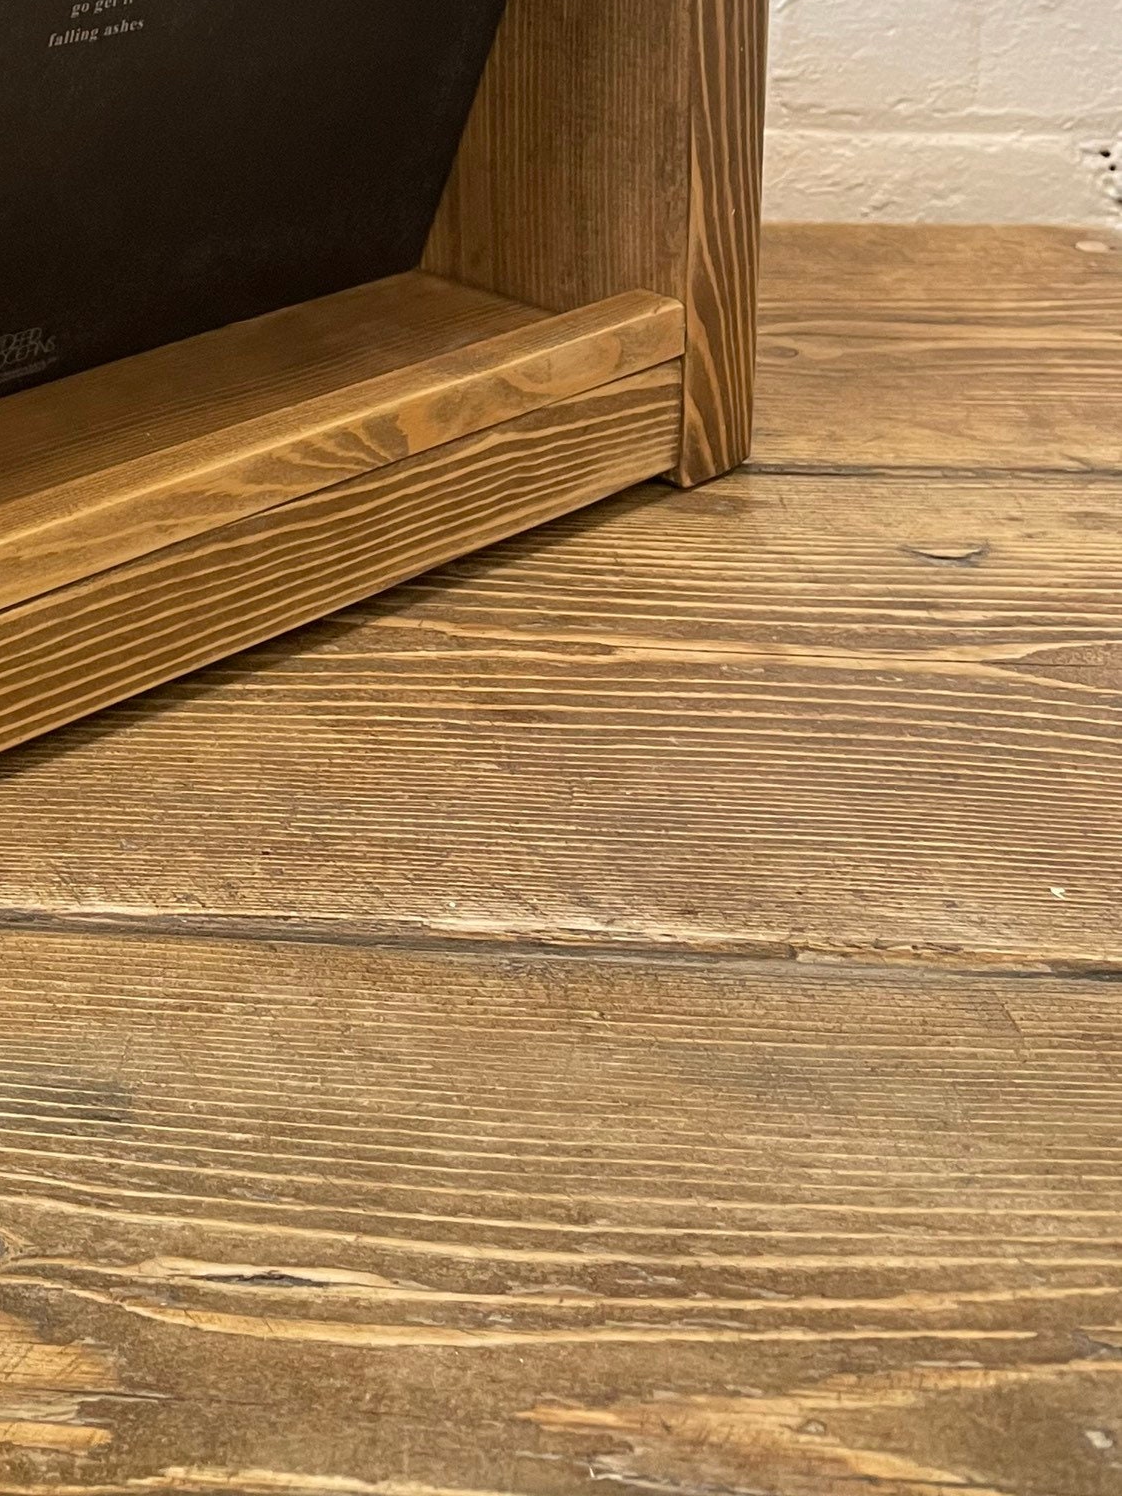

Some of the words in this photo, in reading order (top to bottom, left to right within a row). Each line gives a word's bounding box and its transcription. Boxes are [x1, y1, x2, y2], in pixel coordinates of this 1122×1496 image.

[70, 2, 91, 19] go
[48, 27, 99, 48] falling
[103, 18, 145, 37] ashes
